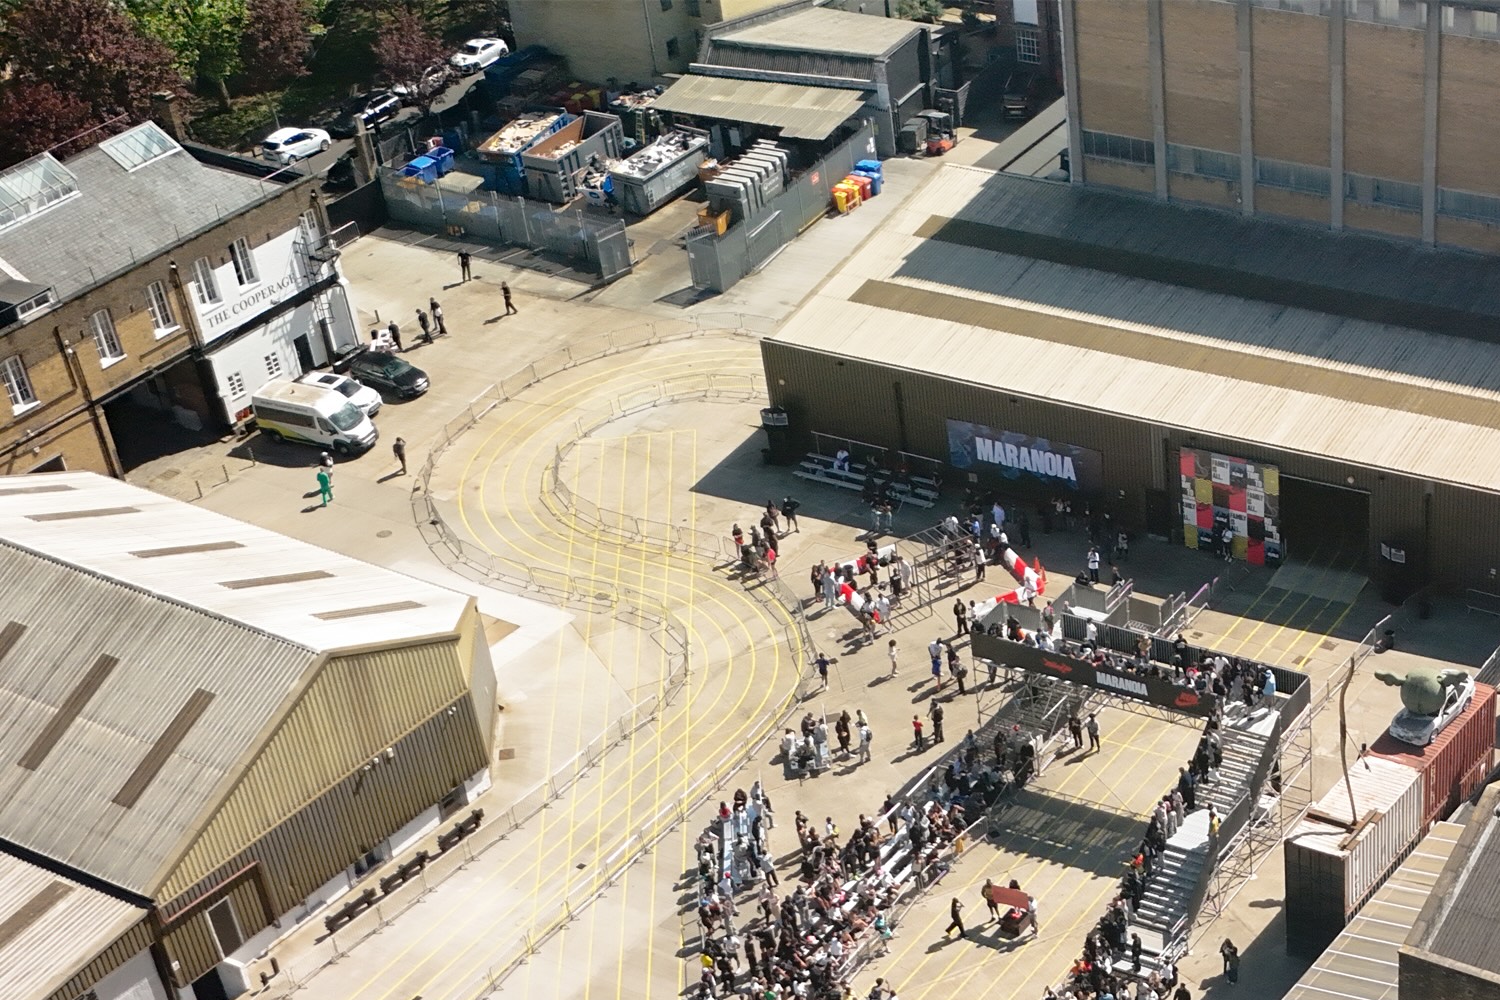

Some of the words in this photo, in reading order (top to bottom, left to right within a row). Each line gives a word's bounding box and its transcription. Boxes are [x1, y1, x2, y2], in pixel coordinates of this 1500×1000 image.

[206, 309, 230, 328] THE
[231, 272, 297, 315] COOPERAGE
[975, 436, 1077, 481] MARANOIA
[1095, 671, 1148, 696] MARANOIA
